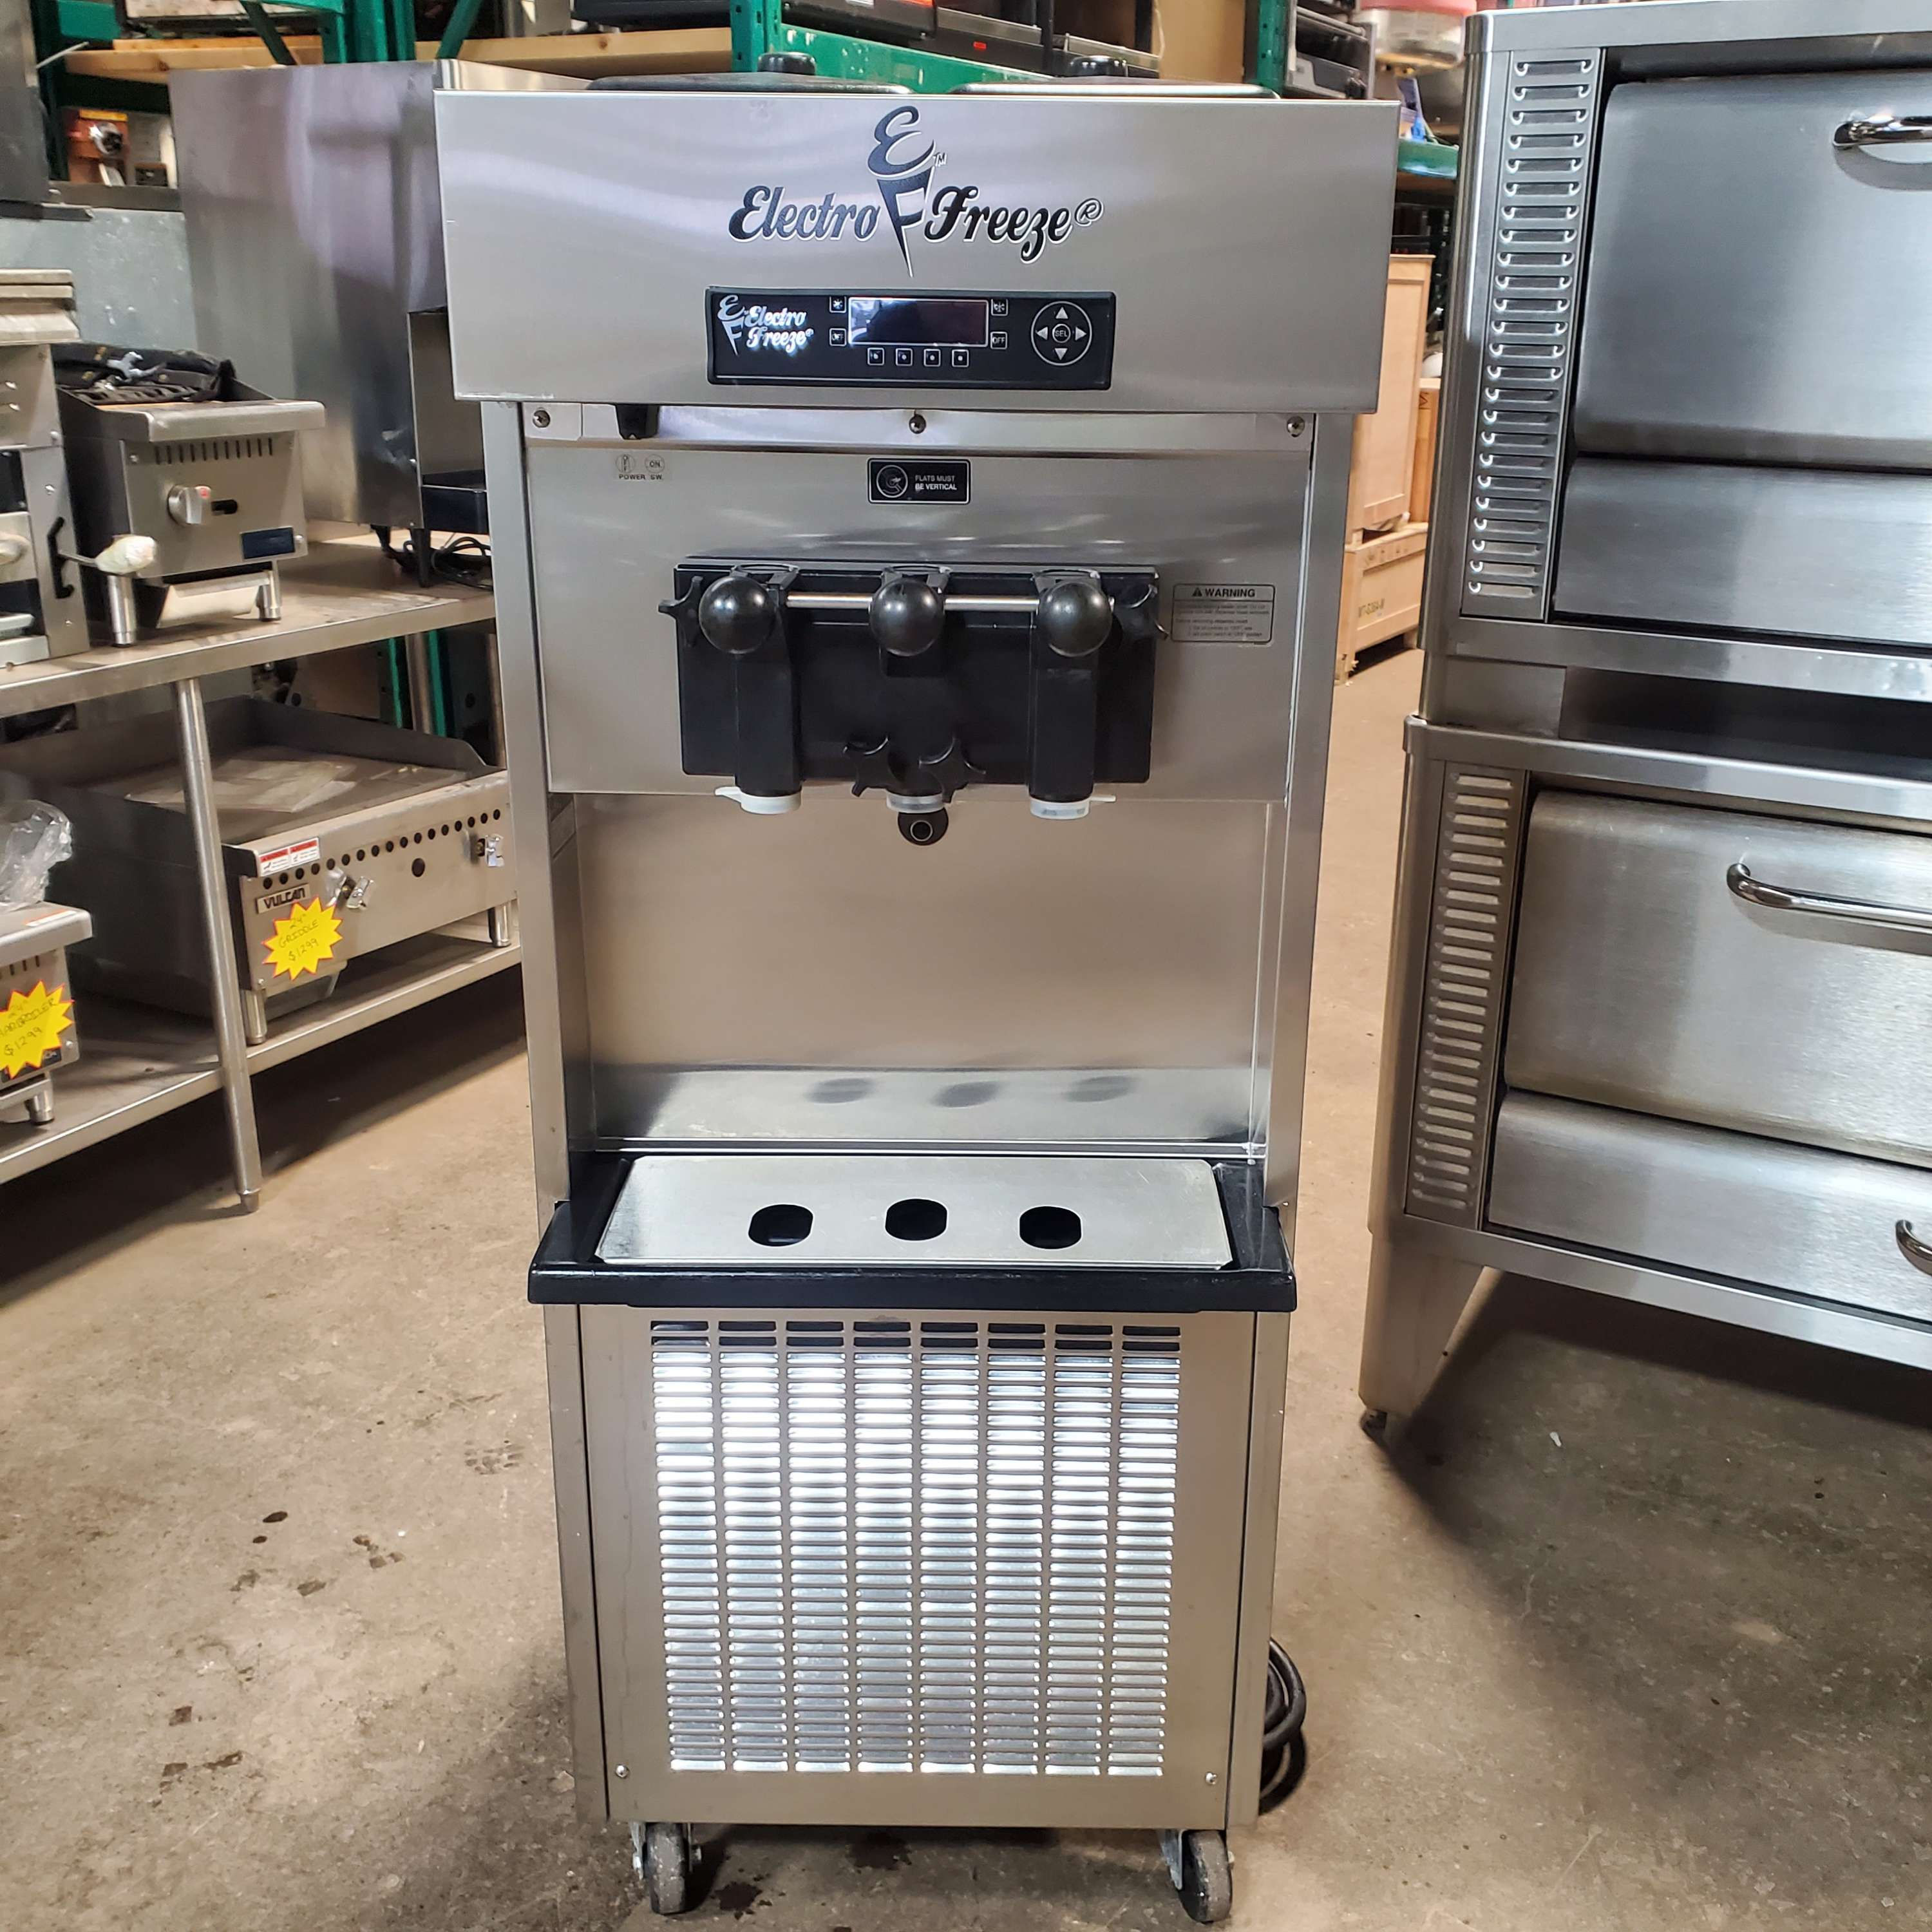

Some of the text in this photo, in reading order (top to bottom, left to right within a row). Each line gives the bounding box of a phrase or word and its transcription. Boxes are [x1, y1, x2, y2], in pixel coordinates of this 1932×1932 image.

[728, 185, 881, 243] Electro
[744, 306, 807, 327] Electro
[1055, 330, 1068, 338] SEL
[649, 460, 661, 468] ON
[1205, 589, 1255, 598] WARNING
[263, 887, 306, 909] VULCAN
